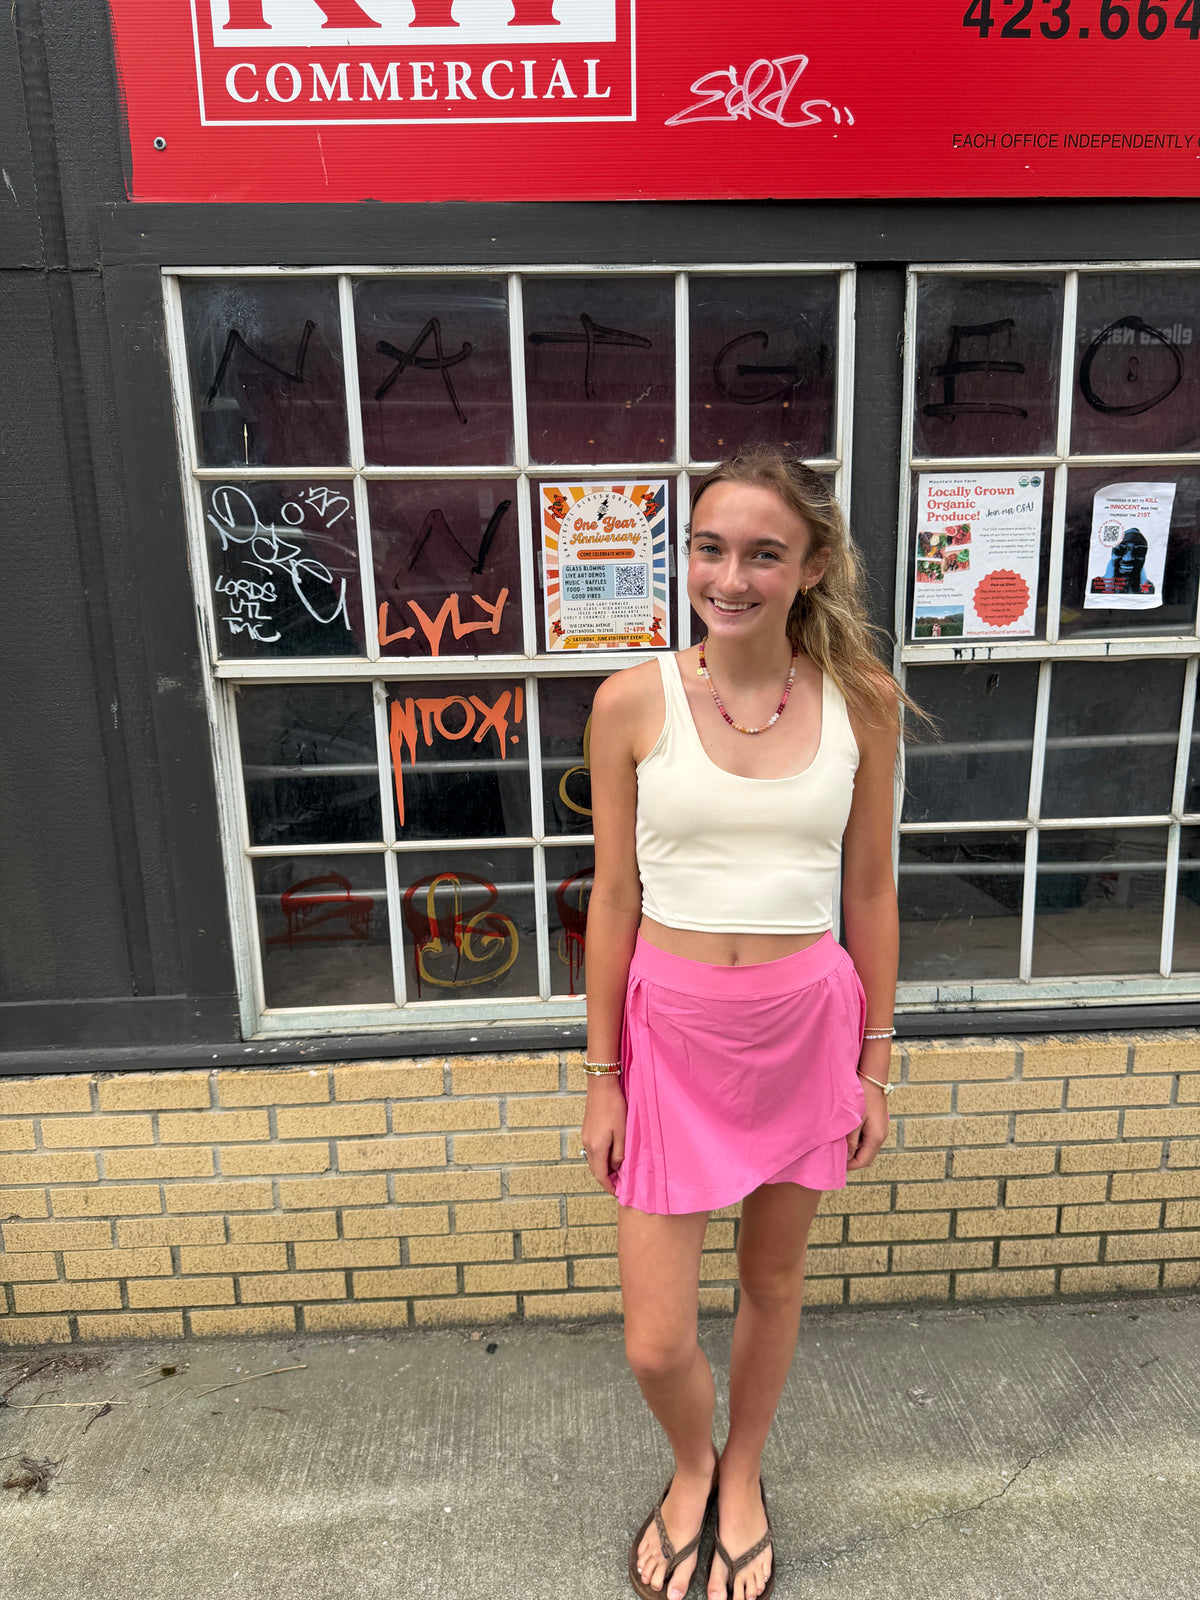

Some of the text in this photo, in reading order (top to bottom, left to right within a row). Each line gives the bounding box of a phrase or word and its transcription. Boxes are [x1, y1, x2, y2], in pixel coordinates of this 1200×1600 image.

[225, 58, 611, 104] COMMERCIAL
[952, 133, 998, 149] EACH
[1000, 133, 1059, 149] OFFICE
[1062, 132, 1195, 149] INDEPENDENTLY
[927, 485, 1015, 498] Locally Grown
[926, 499, 976, 511] Organic
[926, 510, 980, 522] Produce!
[573, 516, 638, 533] One Year
[569, 532, 642, 546] Anniversary
